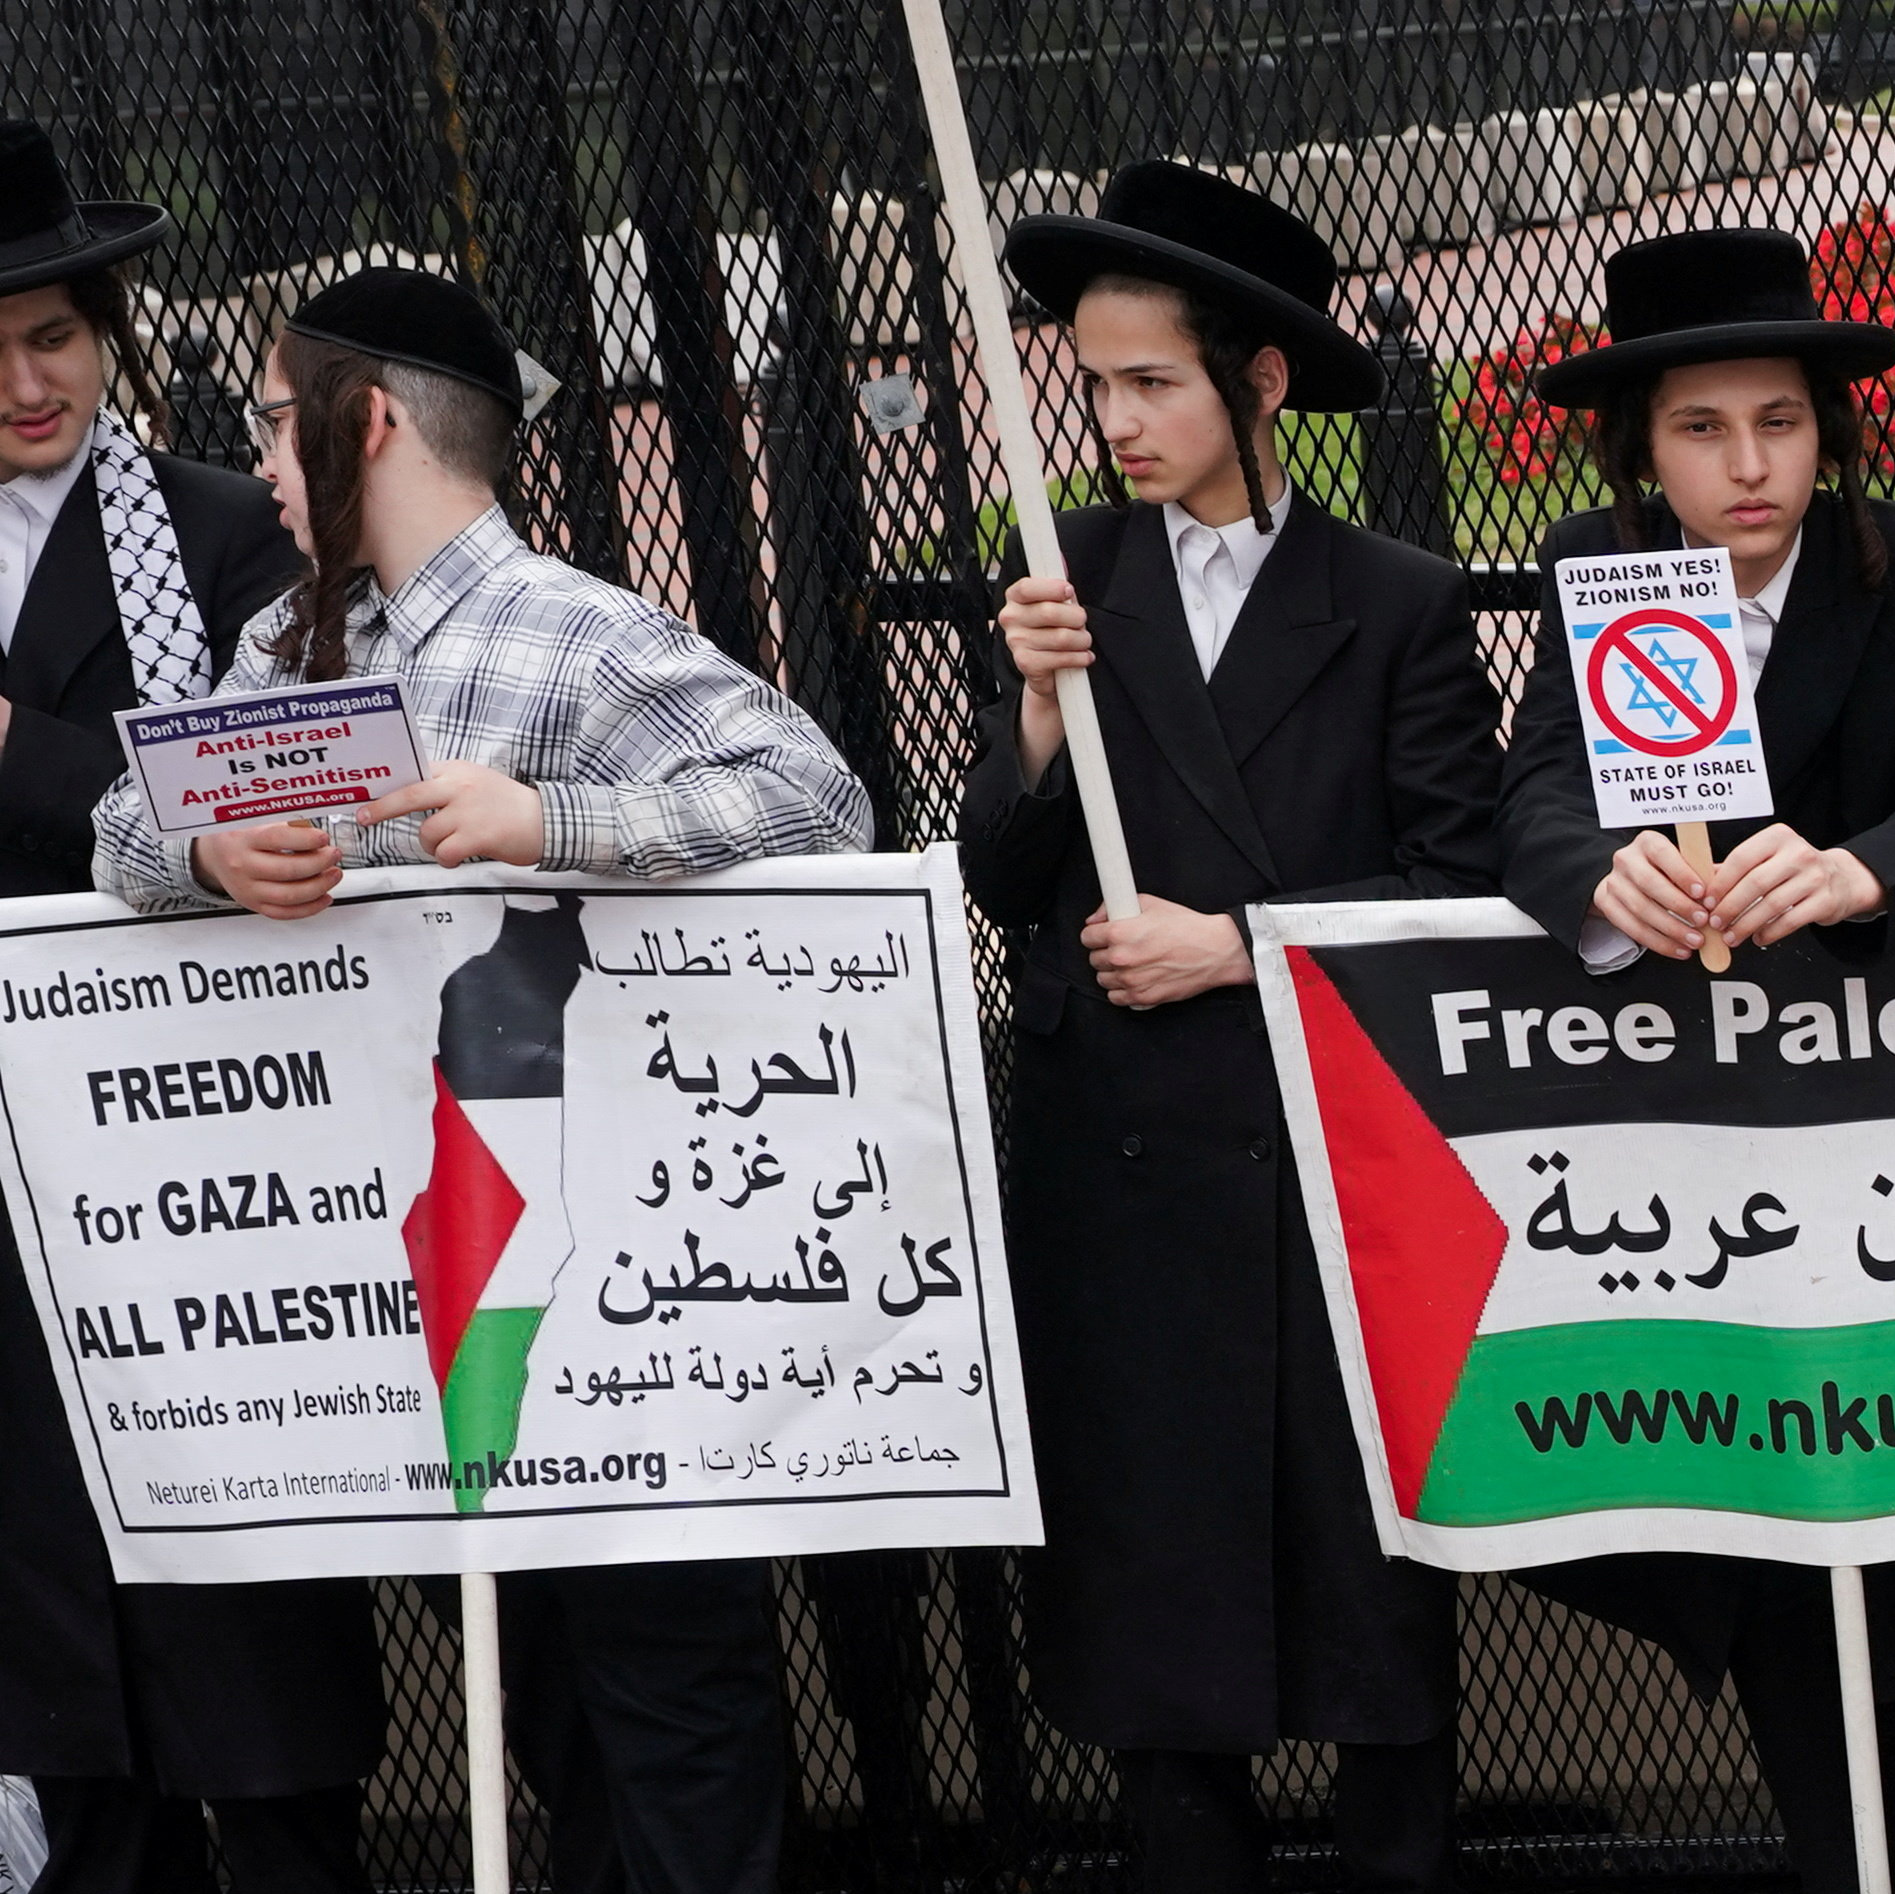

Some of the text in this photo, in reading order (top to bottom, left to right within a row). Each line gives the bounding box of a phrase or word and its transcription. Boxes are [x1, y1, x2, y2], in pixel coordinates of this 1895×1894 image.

[1564, 559, 1721, 585] JUDAISM YES!
[1575, 582, 1718, 606] ZIONISM NO!
[137, 692, 394, 741] Don't Buy Zionist Propaganda
[195, 721, 352, 758] Anti-Israel
[181, 764, 392, 806] Anti-Semitism
[228, 747, 328, 775] Is NOT
[1600, 759, 1756, 784] STATE OF ISRAEL
[227, 792, 356, 817] www.NKUSA.org
[1631, 782, 1733, 802] MUST GO!
[1642, 801, 1727, 815] www.nkusa.org
[2, 944, 370, 1023] Judaism Demands
[594, 928, 909, 993] اليهودية تطالب
[1430, 988, 1676, 1076] Free
[87, 1050, 331, 1126] FREEDOM
[646, 1010, 855, 1117] الحرية
[636, 1133, 891, 1219] إلى غزة و
[73, 1168, 388, 1245] for GAZA and
[1524, 1152, 1800, 1294] عربية
[599, 1227, 962, 1325] كل فلسطين
[74, 1280, 421, 1359] ALL PALESTINE
[555, 1352, 674, 1406] لليهود
[688, 1348, 768, 1407] دولة
[854, 1350, 944, 1403] تحرم
[959, 1362, 983, 1395] و
[107, 1384, 421, 1434] & forbids any Jewish State
[881, 1435, 959, 1468] جماعة
[147, 1479, 218, 1506] Neturei
[222, 1475, 278, 1502] Karta
[283, 1465, 391, 1499] International
[406, 1451, 666, 1491] www.nkusa.org
